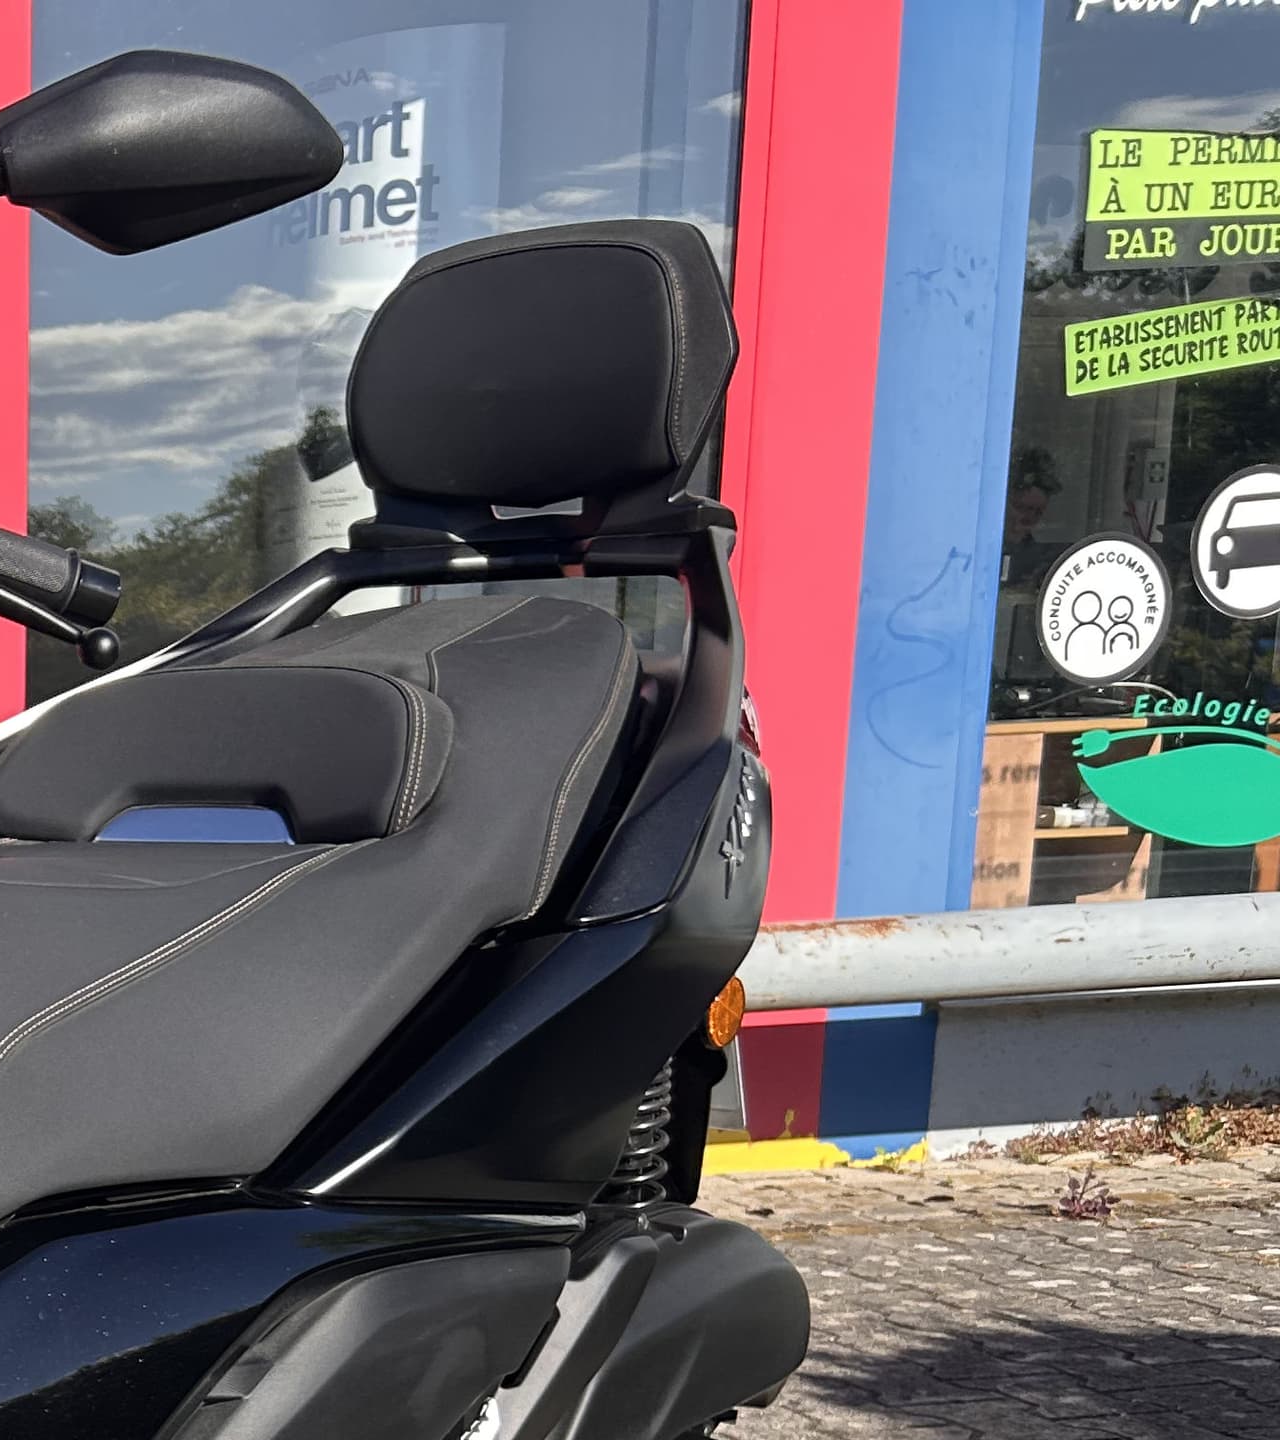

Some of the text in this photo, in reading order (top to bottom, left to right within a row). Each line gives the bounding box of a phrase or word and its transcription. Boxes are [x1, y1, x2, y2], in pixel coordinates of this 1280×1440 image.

[1098, 138, 1142, 168] LE
[1100, 177, 1126, 214] À
[1145, 182, 1193, 212] UN
[1105, 227, 1176, 260] PAR
[1075, 307, 1226, 354] ETABLISSEMENT
[1076, 357, 1099, 384] DE
[1107, 351, 1130, 377] LA
[1139, 335, 1228, 372] SECURITE
[1049, 551, 1159, 642] CONDUITE ACCOMPAGNÉE
[1132, 691, 1271, 726] Ecologie
